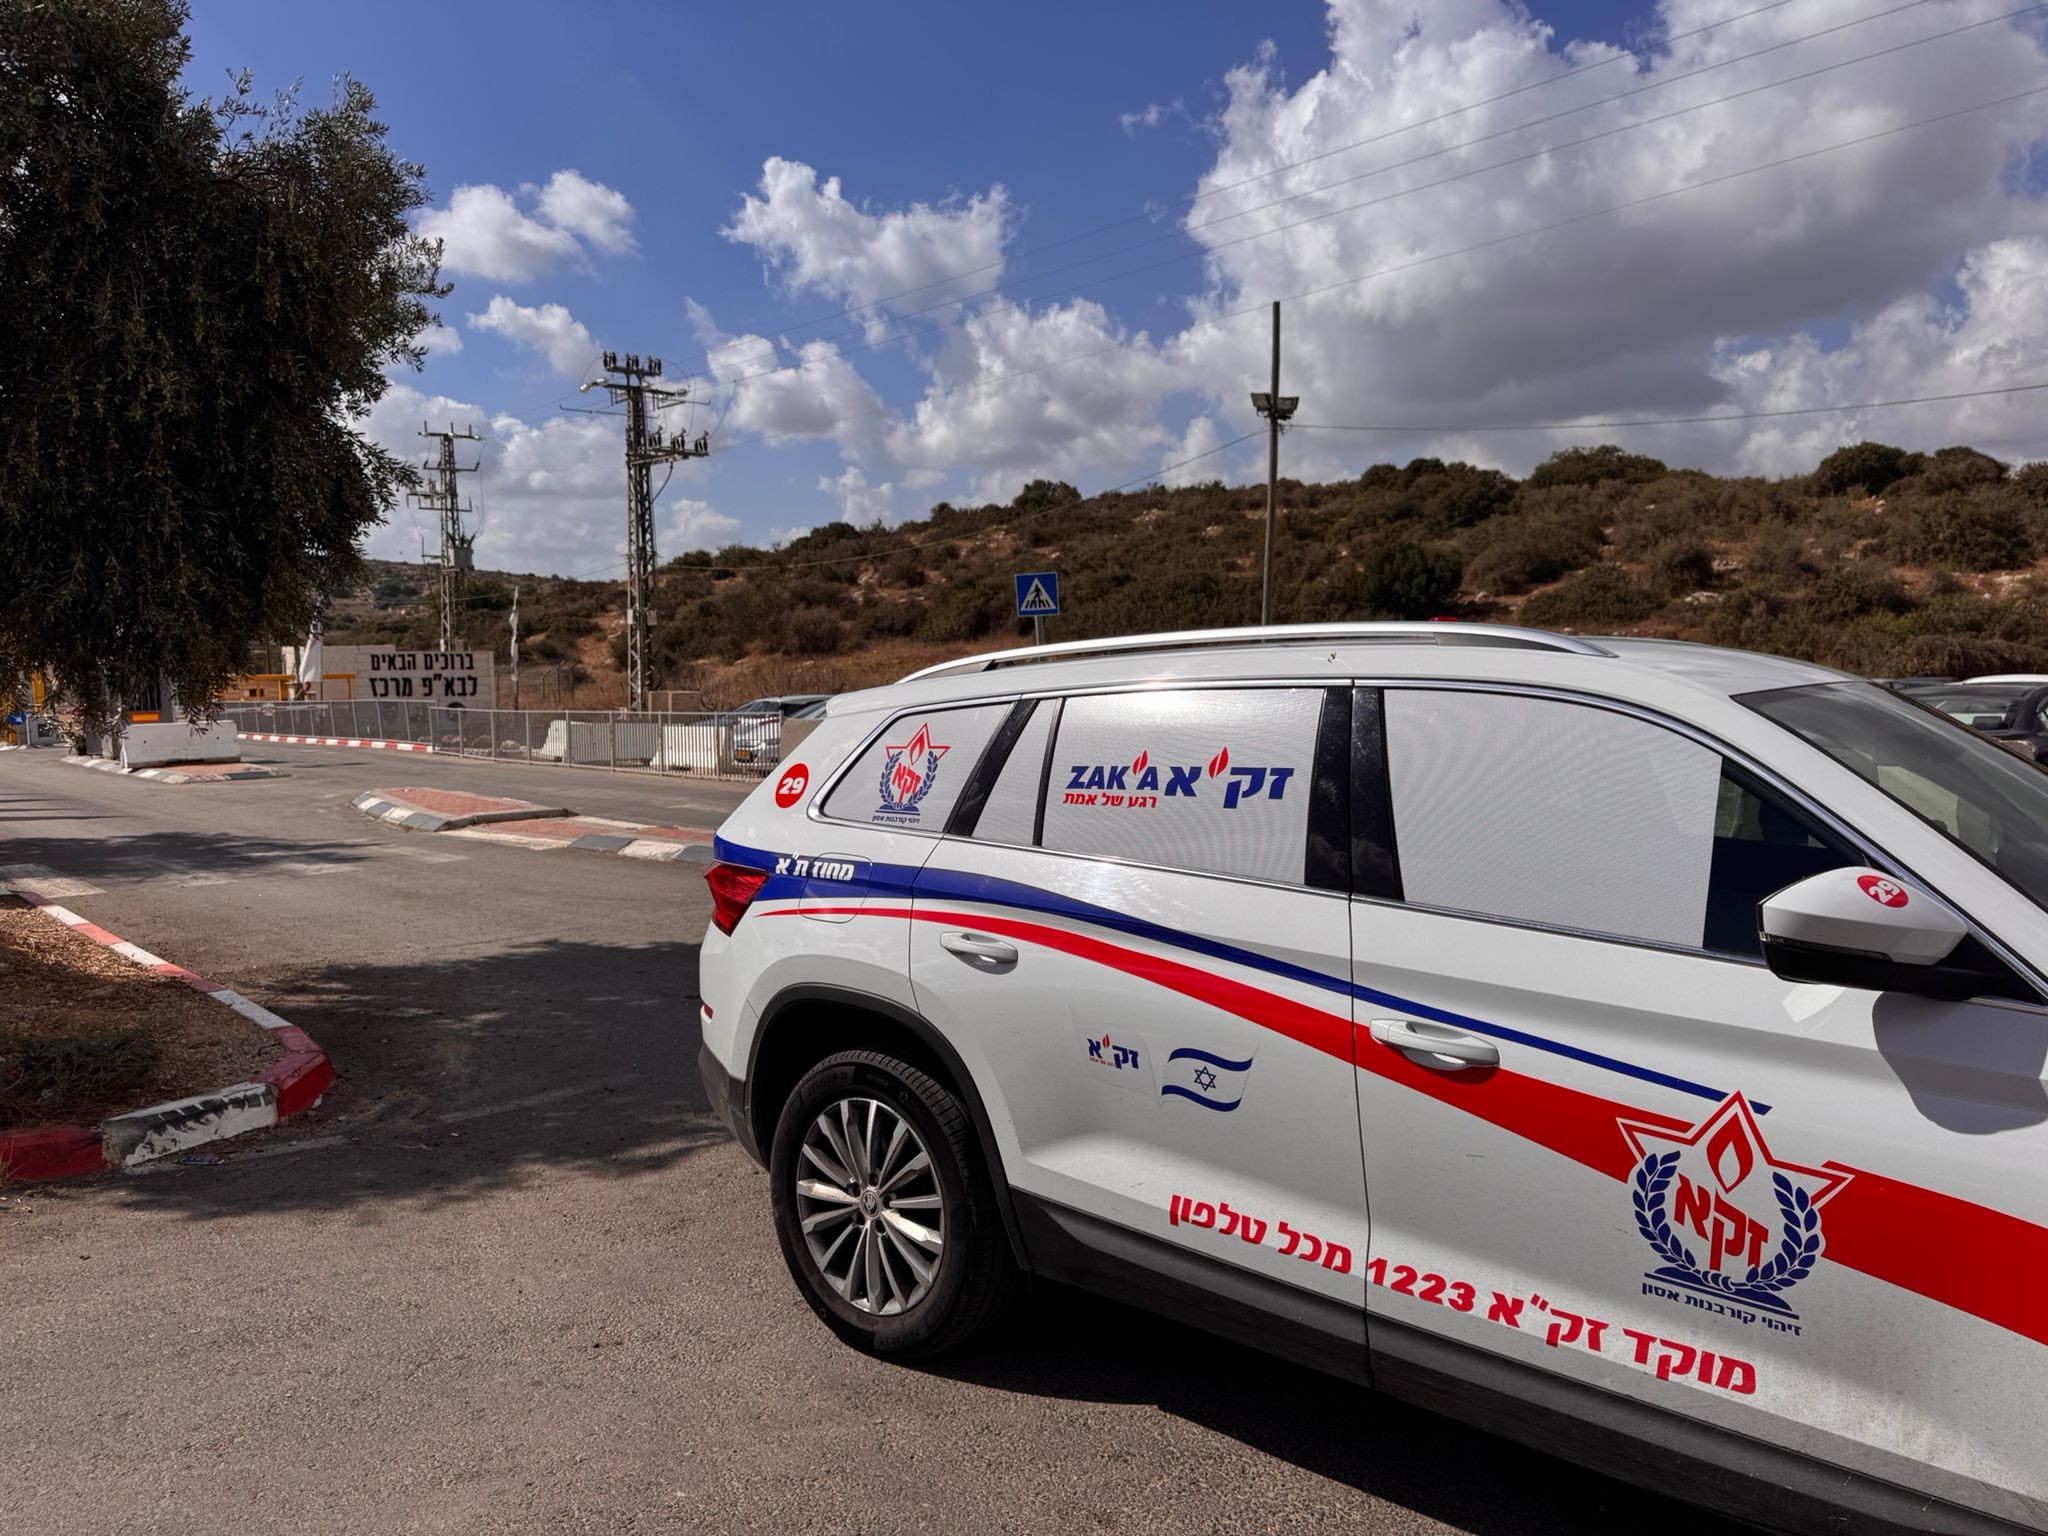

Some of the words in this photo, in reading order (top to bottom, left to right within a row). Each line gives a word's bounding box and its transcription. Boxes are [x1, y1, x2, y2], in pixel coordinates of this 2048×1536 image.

[371, 653, 416, 671] הבאים
[424, 653, 474, 670] ברוכים
[369, 677, 413, 697] מרכז
[778, 776, 806, 795] 29
[1062, 792, 1096, 806] אמת
[1100, 792, 1123, 808] של
[1126, 796, 1157, 809] רגע
[811, 861, 855, 881] מחוז
[1868, 880, 1901, 903] 29
[1168, 1194, 1268, 1245] טלפון
[1277, 1221, 1353, 1275] מכל
[1367, 1257, 1476, 1312] 1223
[1641, 1282, 1680, 1302] אסון
[1685, 1293, 1756, 1325] קורבנות
[1487, 1291, 1609, 1352] זק"א
[1761, 1315, 1802, 1337] זיהוי
[1622, 1327, 1757, 1396] מוקד
